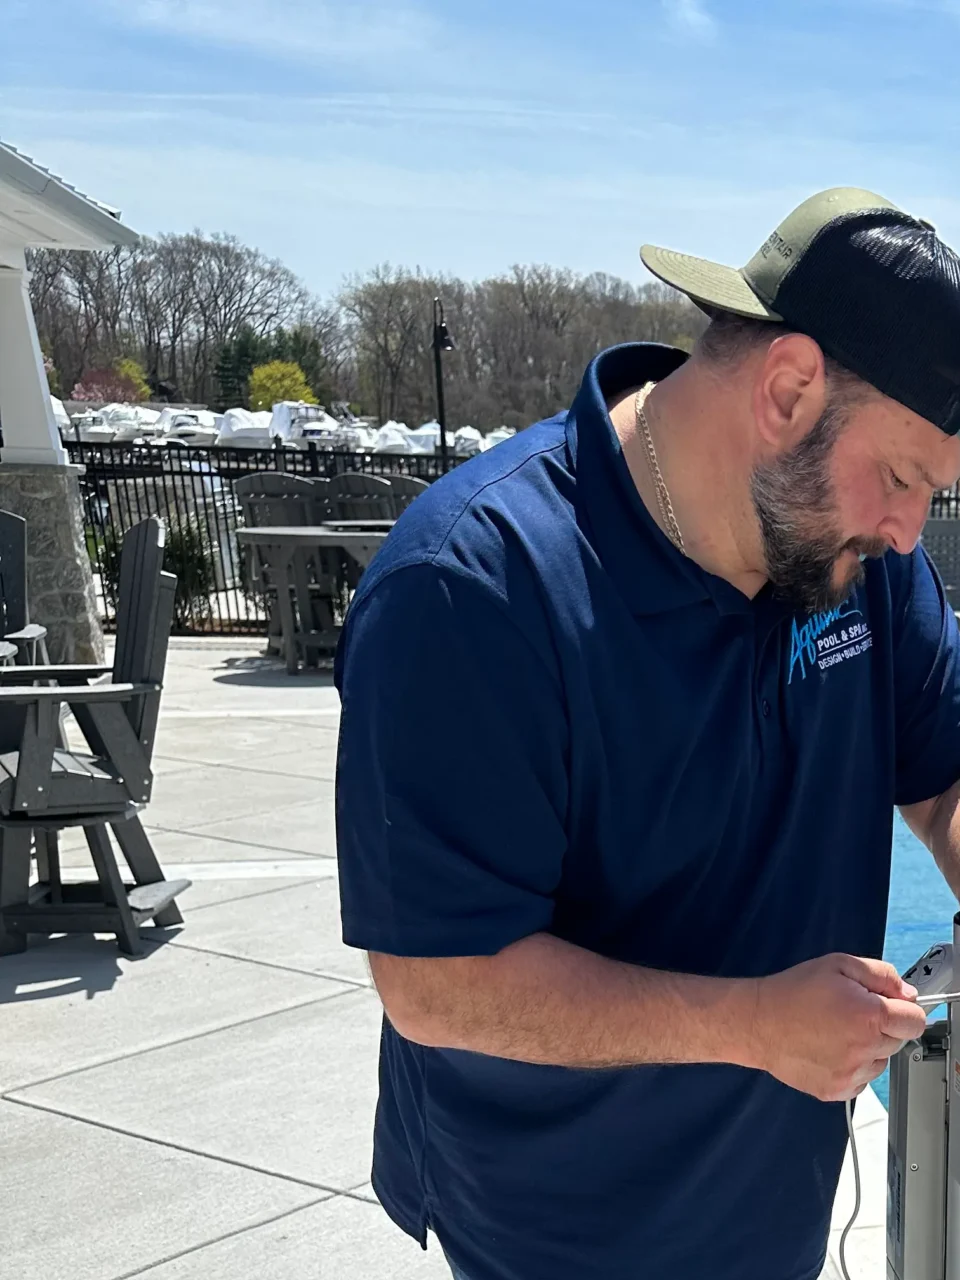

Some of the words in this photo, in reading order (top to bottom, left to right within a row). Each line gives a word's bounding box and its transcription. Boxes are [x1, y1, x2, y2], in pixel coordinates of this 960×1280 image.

[817, 633, 841, 652] POOL
[840, 629, 849, 642] &
[848, 623, 862, 638] SPA
